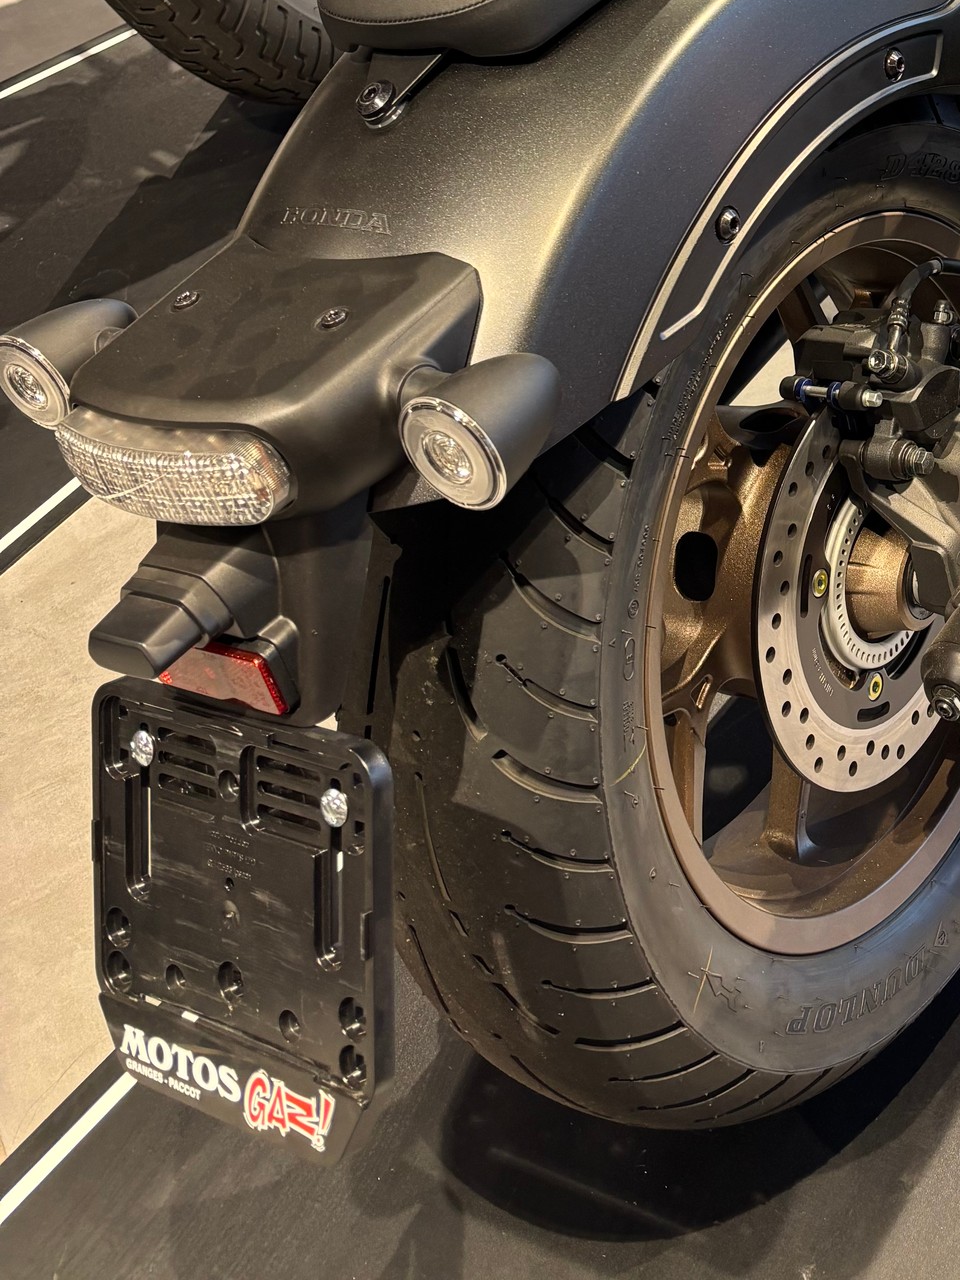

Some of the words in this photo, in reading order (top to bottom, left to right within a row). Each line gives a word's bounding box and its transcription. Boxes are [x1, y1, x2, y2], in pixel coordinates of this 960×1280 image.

[279, 206, 393, 237] HONDA
[785, 943, 928, 1036] DUNLOP
[119, 1023, 242, 1103] MOTOS
[126, 1057, 163, 1085] GRANGES
[168, 1077, 201, 1101] PACCOT
